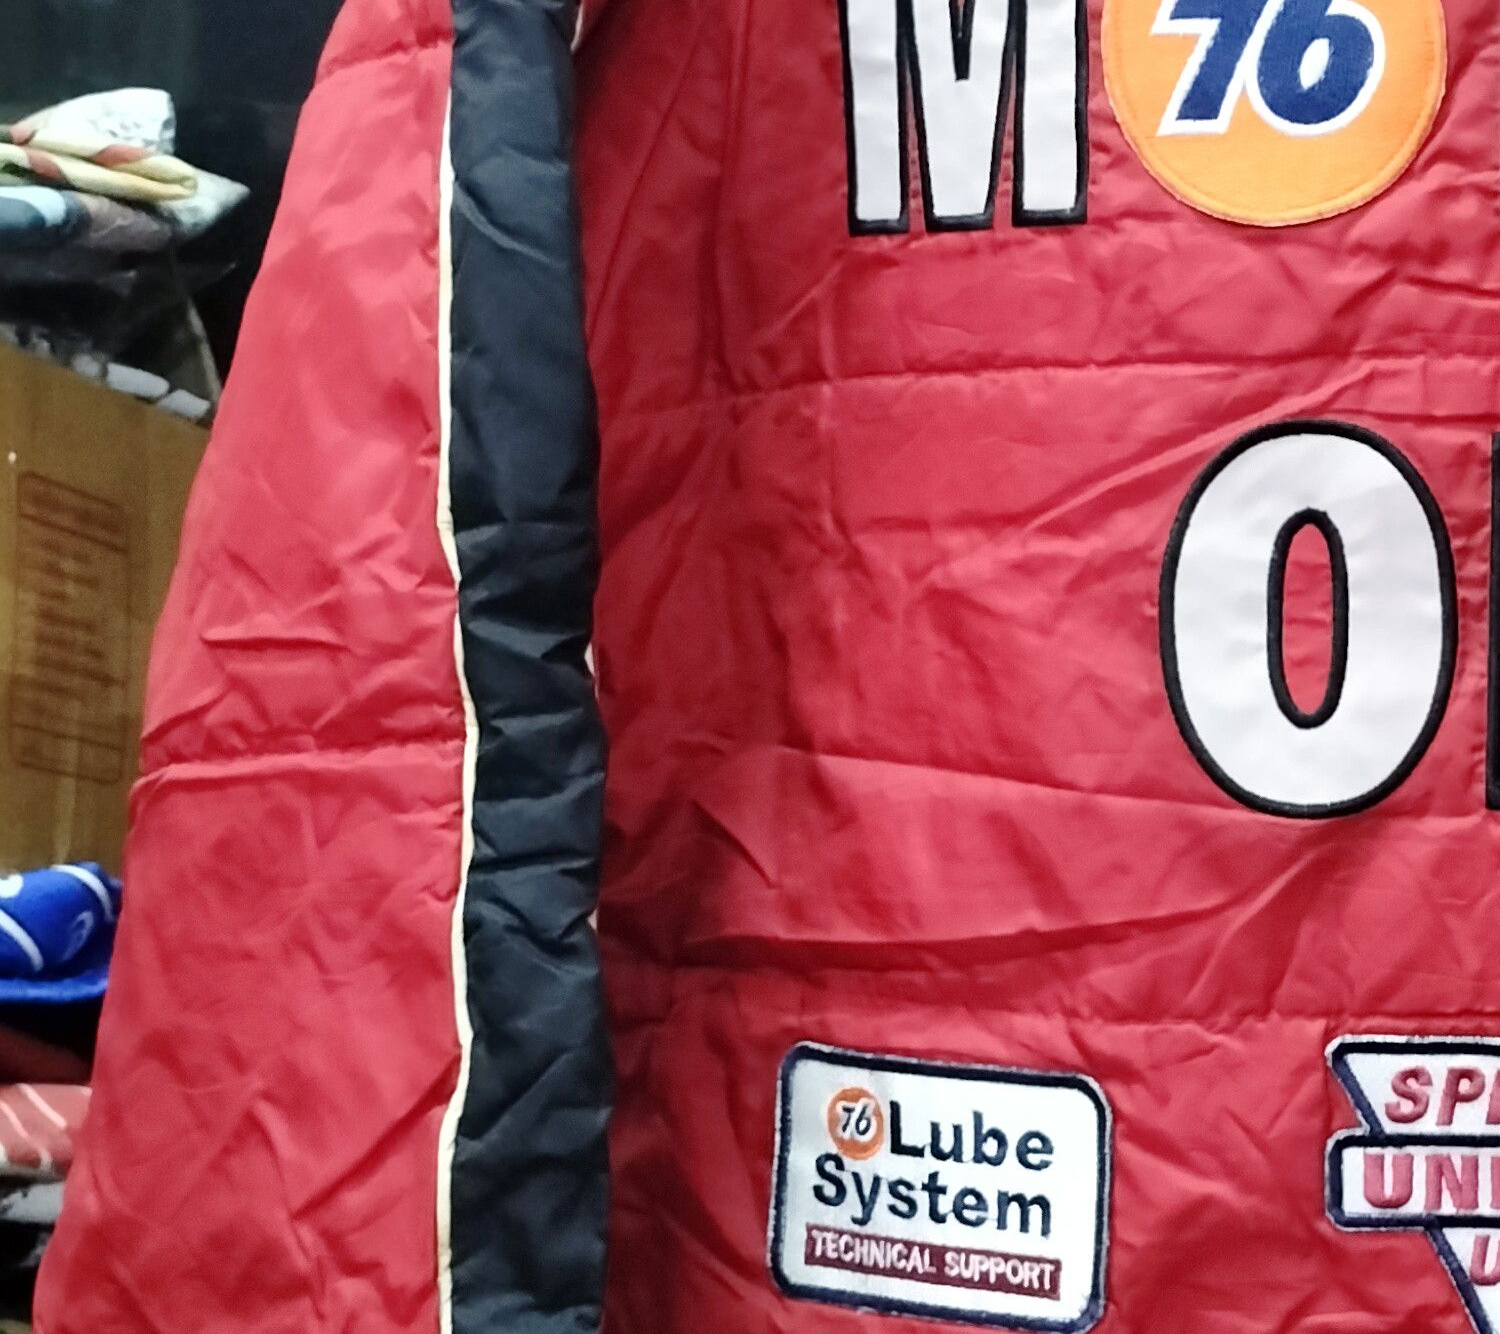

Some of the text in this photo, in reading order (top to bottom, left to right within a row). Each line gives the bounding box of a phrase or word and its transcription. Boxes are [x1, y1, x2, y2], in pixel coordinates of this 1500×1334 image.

[838, 1099, 1054, 1170] 76 Lube
[813, 1153, 1051, 1239] System
[811, 1230, 1056, 1291] TECHNICAL SUPPORT
